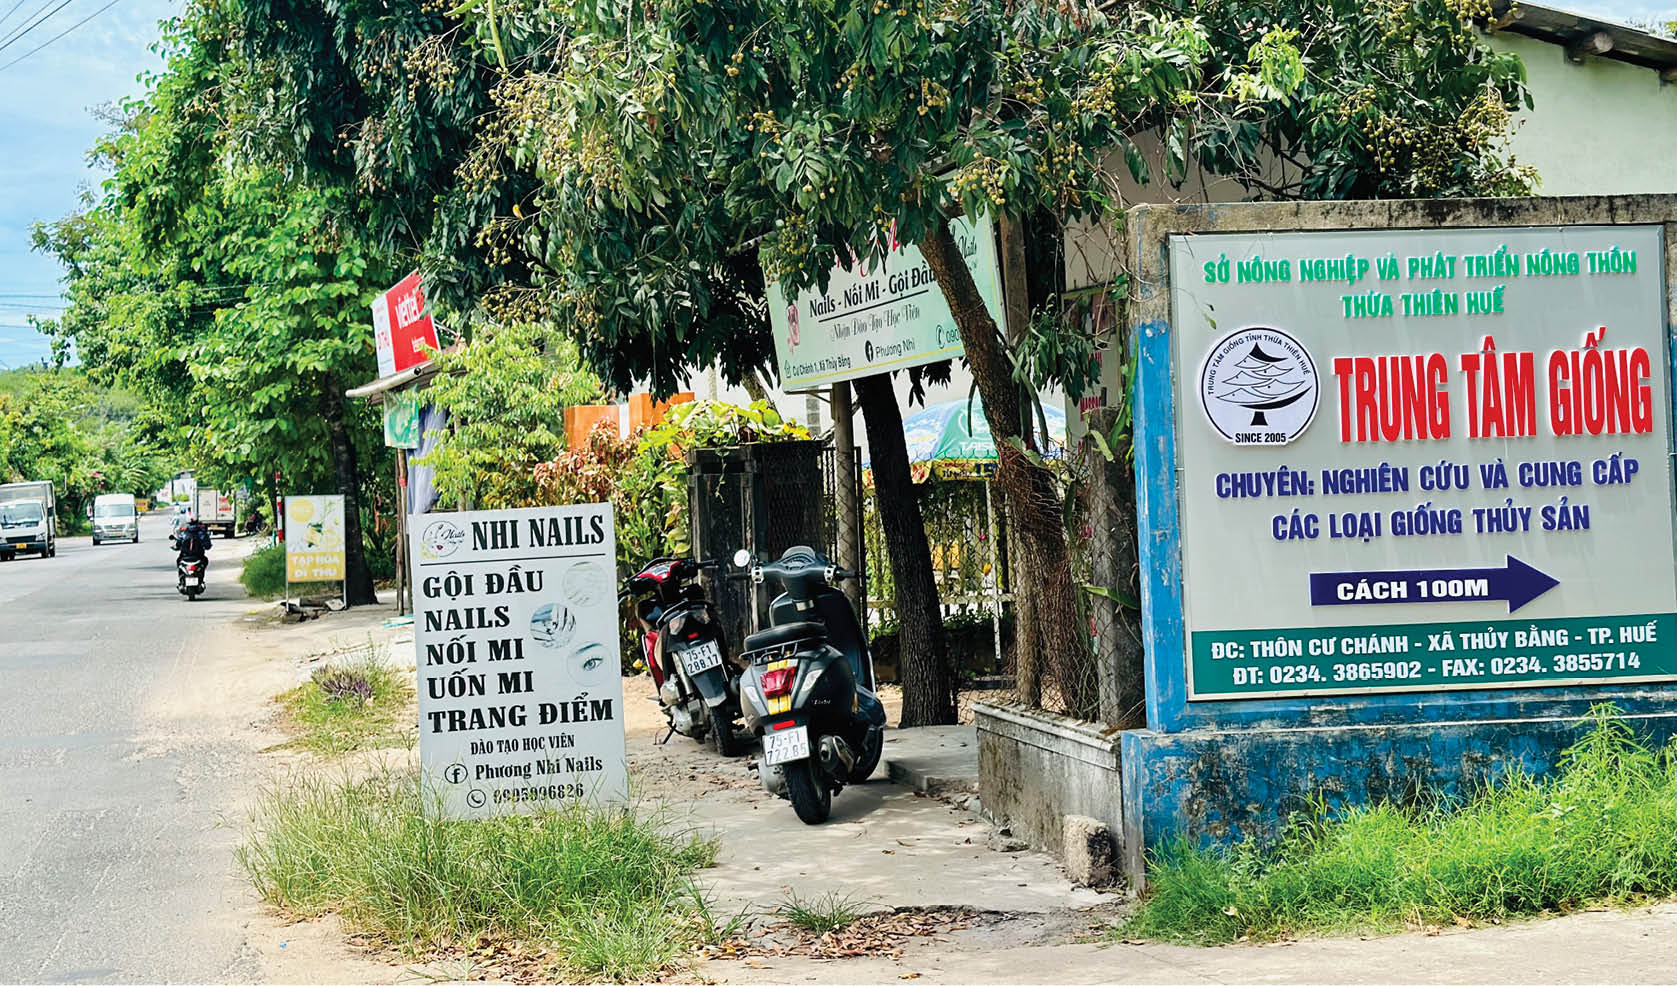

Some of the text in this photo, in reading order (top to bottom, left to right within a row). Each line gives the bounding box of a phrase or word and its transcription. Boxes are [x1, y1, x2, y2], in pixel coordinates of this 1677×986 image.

[1203, 244, 1637, 286] SỞ NÔNG NGHIỆP VÀ PHÁT TRIỂN NÔNG THÔN
[809, 295, 836, 318] Nails
[844, 283, 863, 309] Nối
[865, 281, 880, 300] Mi
[889, 266, 909, 297] Gội
[1340, 284, 1506, 318] THỪA THIÊN HUẾ
[902, 338, 915, 352] Nhi
[1207, 369, 1217, 395] TRUNG
[1212, 352, 1225, 368] TÂM
[1283, 342, 1300, 361] THIÊN
[1333, 326, 1653, 443] TRUNG TÂM GIỐNG
[1235, 433, 1287, 443] SINCE 2005
[1216, 451, 1640, 498] CHUYÊN: NGHIÊN CỨU VÀ CUNG CẤP
[471, 515, 605, 551] NHI NAILS
[1272, 496, 1591, 543] CÁC LOẠI GIỐNG THỦY SẢN
[423, 564, 544, 601] GỘI ĐẦU
[1337, 578, 1489, 601] CÁCH 100M
[424, 606, 511, 633] NAILS
[426, 634, 525, 666] NỐI MI
[686, 645, 712, 661] 75-F1
[1211, 641, 1245, 660] ĐC:
[1250, 637, 1303, 658] THÔN
[1308, 636, 1337, 656] CƯ
[1341, 633, 1409, 654] CHÁNH
[1427, 630, 1455, 651] XÃ
[1459, 626, 1509, 650] THỦY
[1514, 624, 1569, 648] BẰNG
[1587, 627, 1614, 645] TP.
[1619, 620, 1658, 643] HUẾ
[687, 653, 719, 673] 288.17
[1232, 667, 1264, 685] ĐT:
[1269, 664, 1327, 684] 0234.
[1333, 661, 1422, 682] 3865902
[1441, 658, 1485, 677] FAX:
[1490, 655, 1548, 676] 0234.
[1553, 651, 1641, 672] 3855714
[427, 667, 535, 700] UỐN MI
[428, 692, 614, 734] TRANG ĐIỂM
[470, 732, 575, 755] ĐÀO TẠO HỌC VIÊN
[767, 742, 807, 762] 722.85
[770, 730, 800, 749] 75-F1
[475, 756, 603, 780] Phương Nhi Nails
